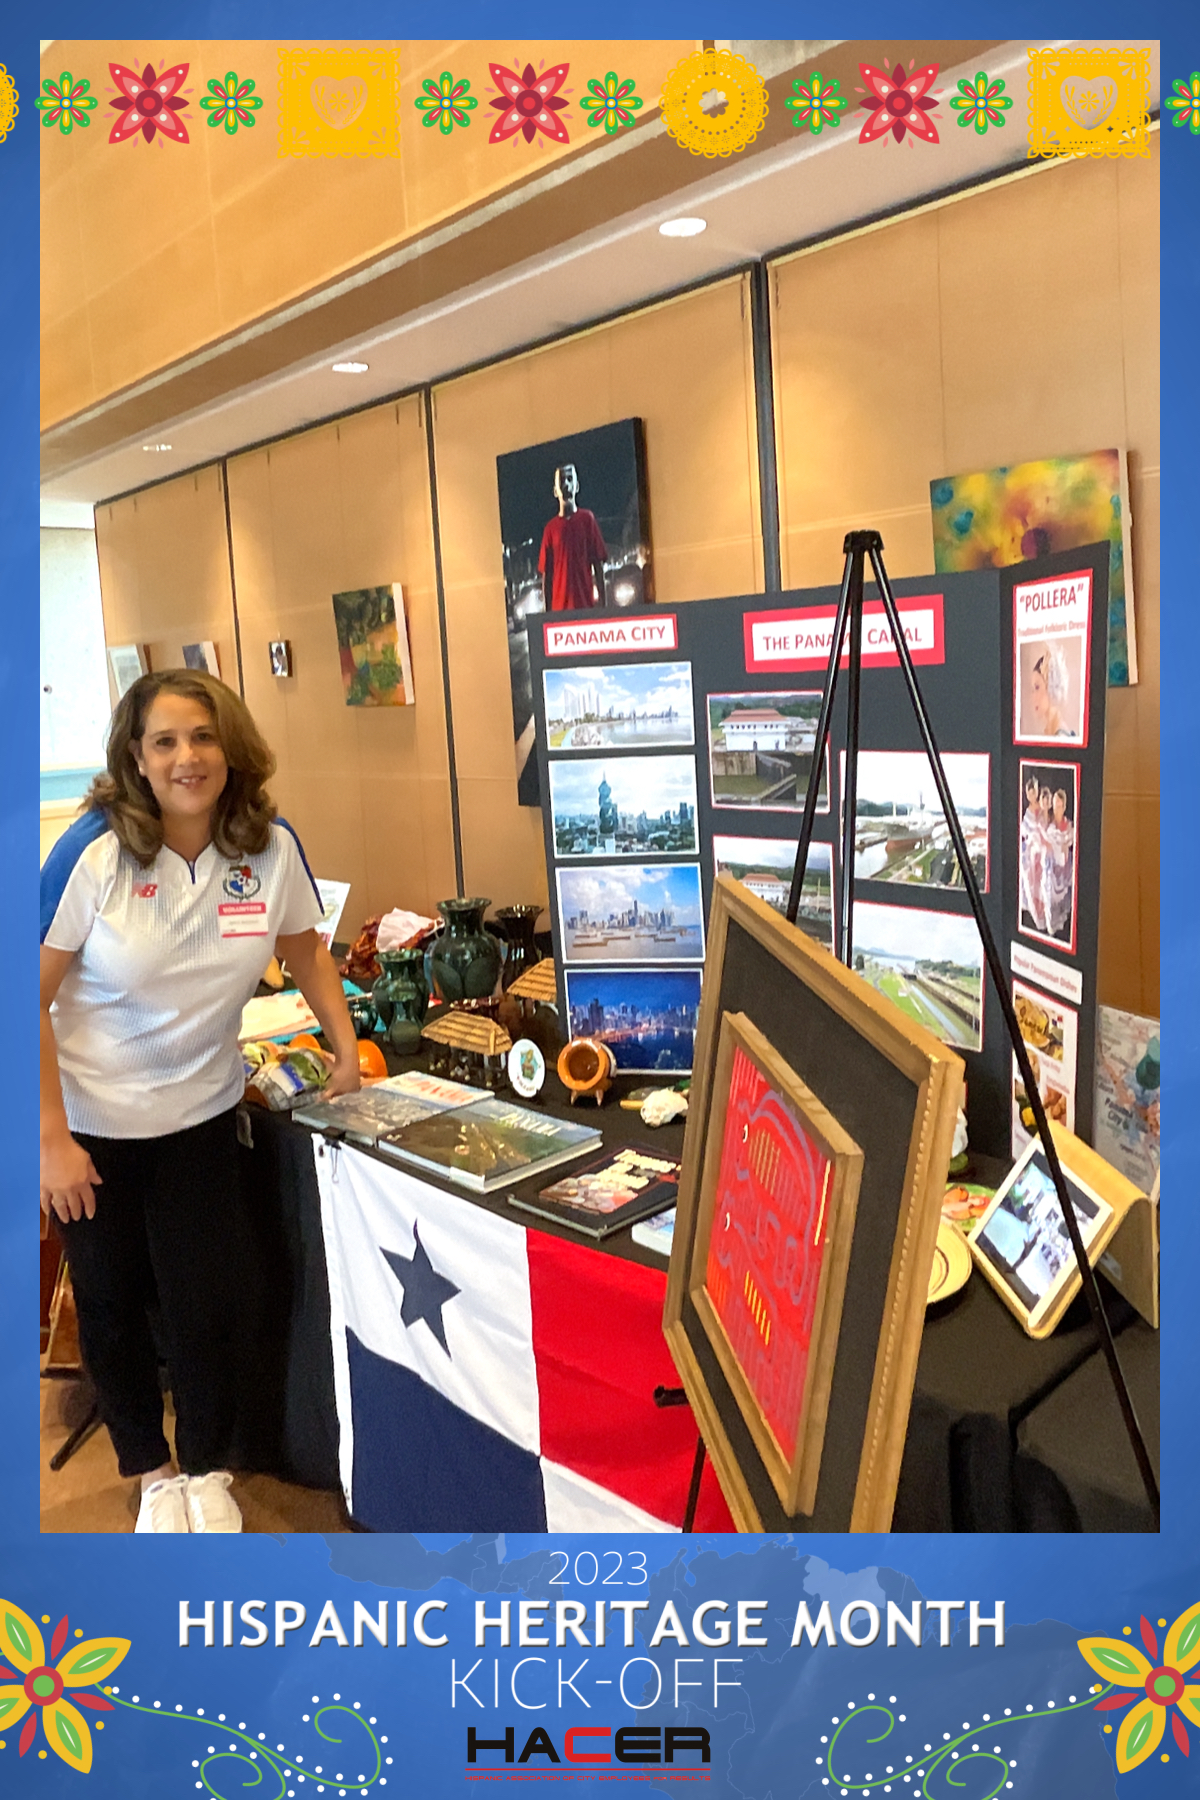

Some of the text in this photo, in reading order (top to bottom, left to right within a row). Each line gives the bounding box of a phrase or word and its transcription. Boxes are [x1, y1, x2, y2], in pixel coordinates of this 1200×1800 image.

[553, 625, 666, 647] PANAMA CITY
[762, 635, 790, 651] THE
